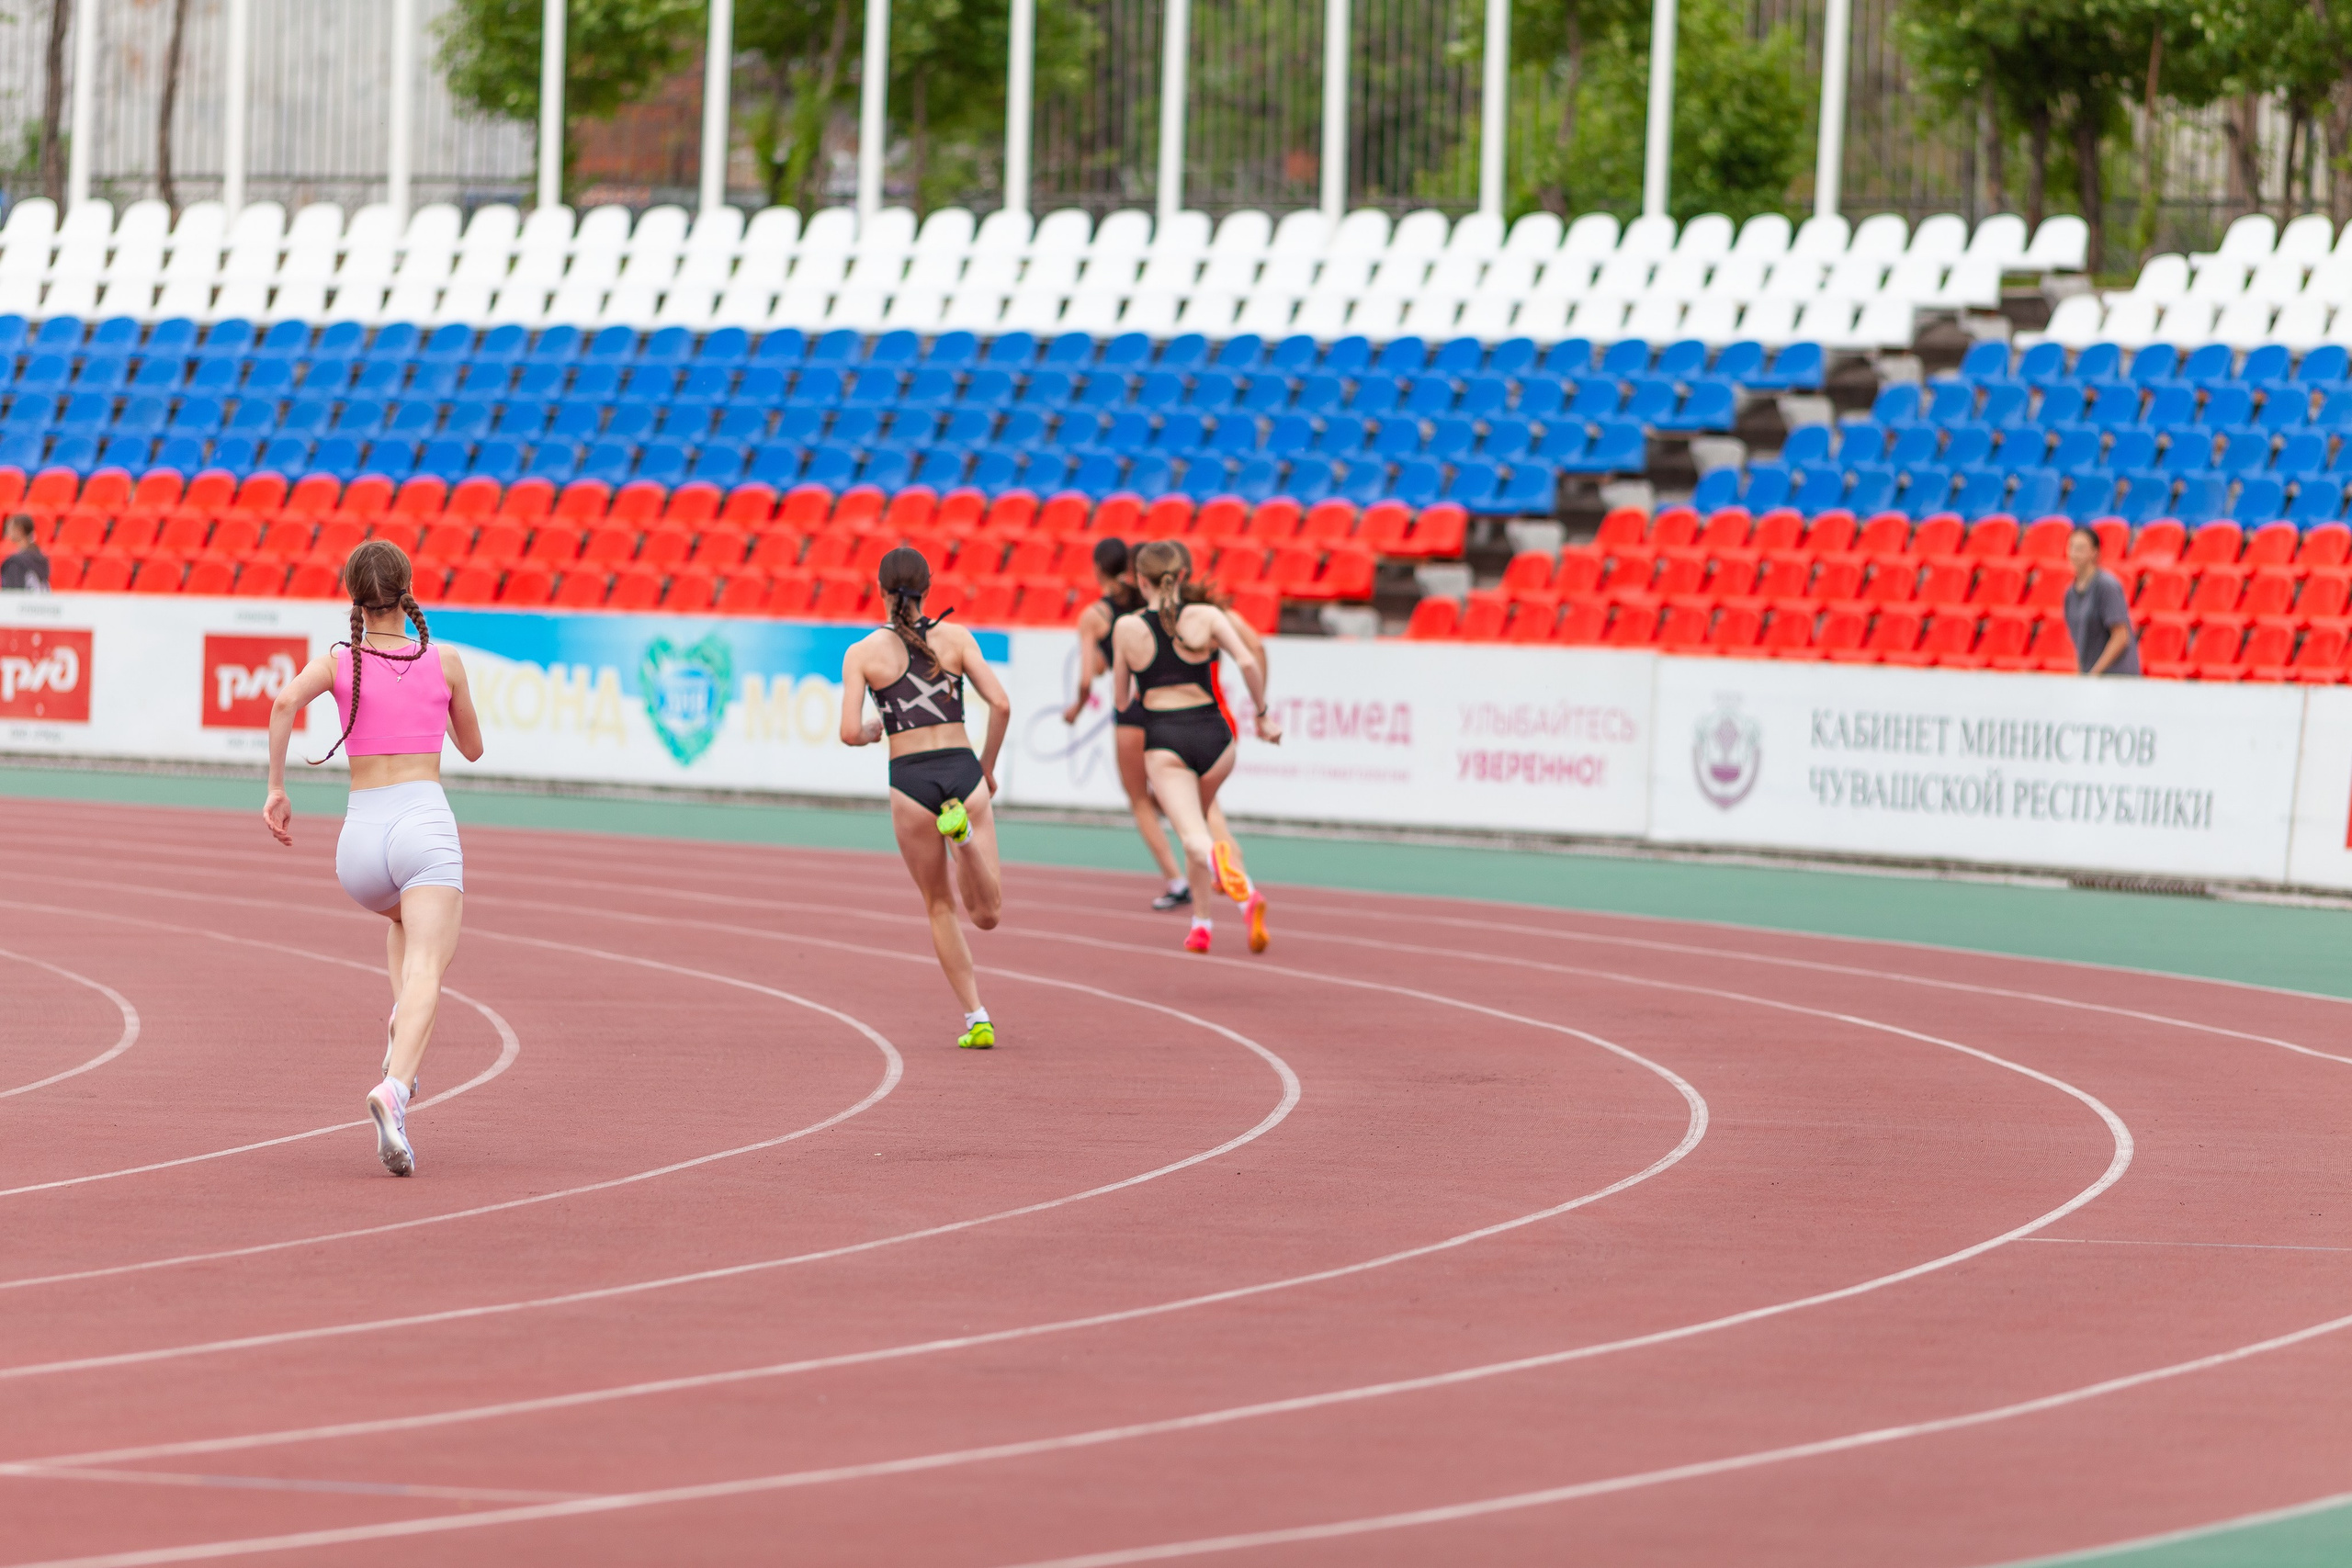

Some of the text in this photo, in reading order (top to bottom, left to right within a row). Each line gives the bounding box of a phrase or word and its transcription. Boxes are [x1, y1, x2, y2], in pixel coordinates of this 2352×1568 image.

[474, 659, 628, 748] КОНД
[1457, 699, 1639, 743] УЛЫБАЙТЕСЬ
[1456, 748, 1607, 787] УВЕРЕННО!
[1809, 706, 2158, 768] КАБИНЕТ МИНИСТРОВ
[1807, 764, 2214, 830] ЧУВАШСКОЙ РЕСПУБЛИКИ
